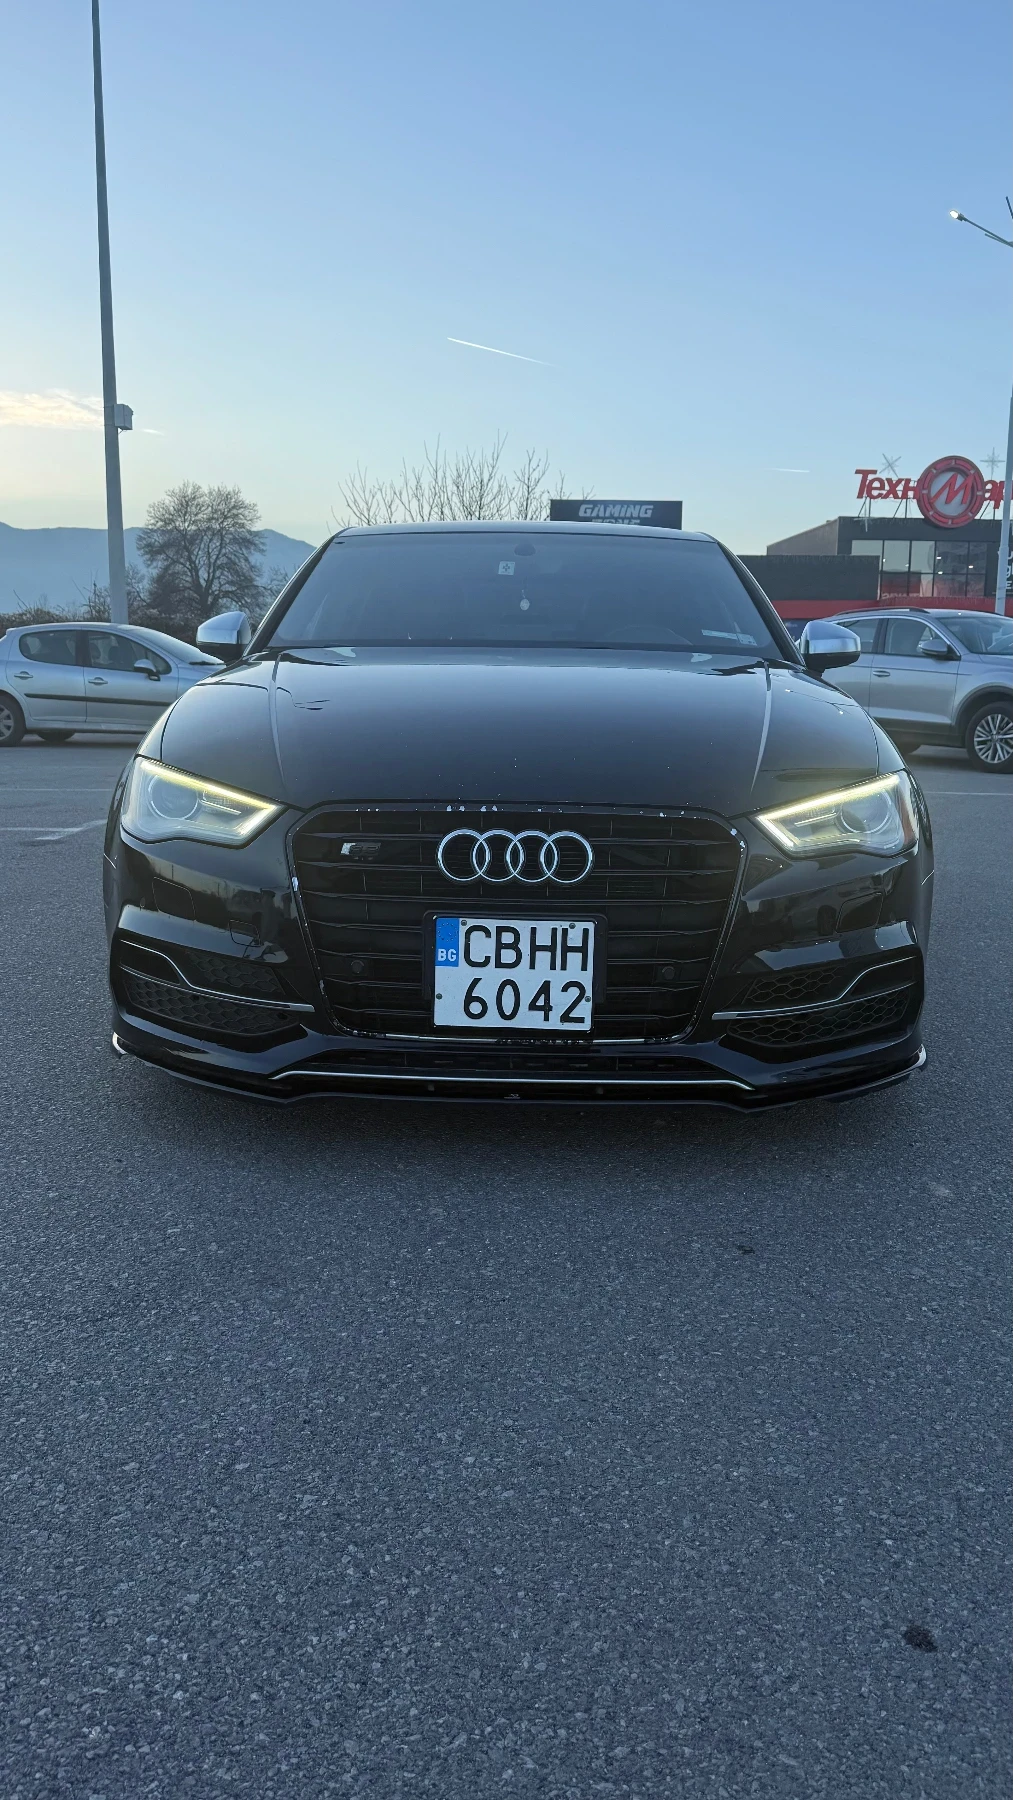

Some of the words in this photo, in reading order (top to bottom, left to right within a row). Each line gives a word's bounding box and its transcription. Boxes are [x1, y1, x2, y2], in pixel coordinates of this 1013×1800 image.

[578, 504, 654, 518] GAMING
[437, 948, 457, 962] BG
[463, 924, 590, 972] CBHH
[463, 977, 587, 1024] 6042
